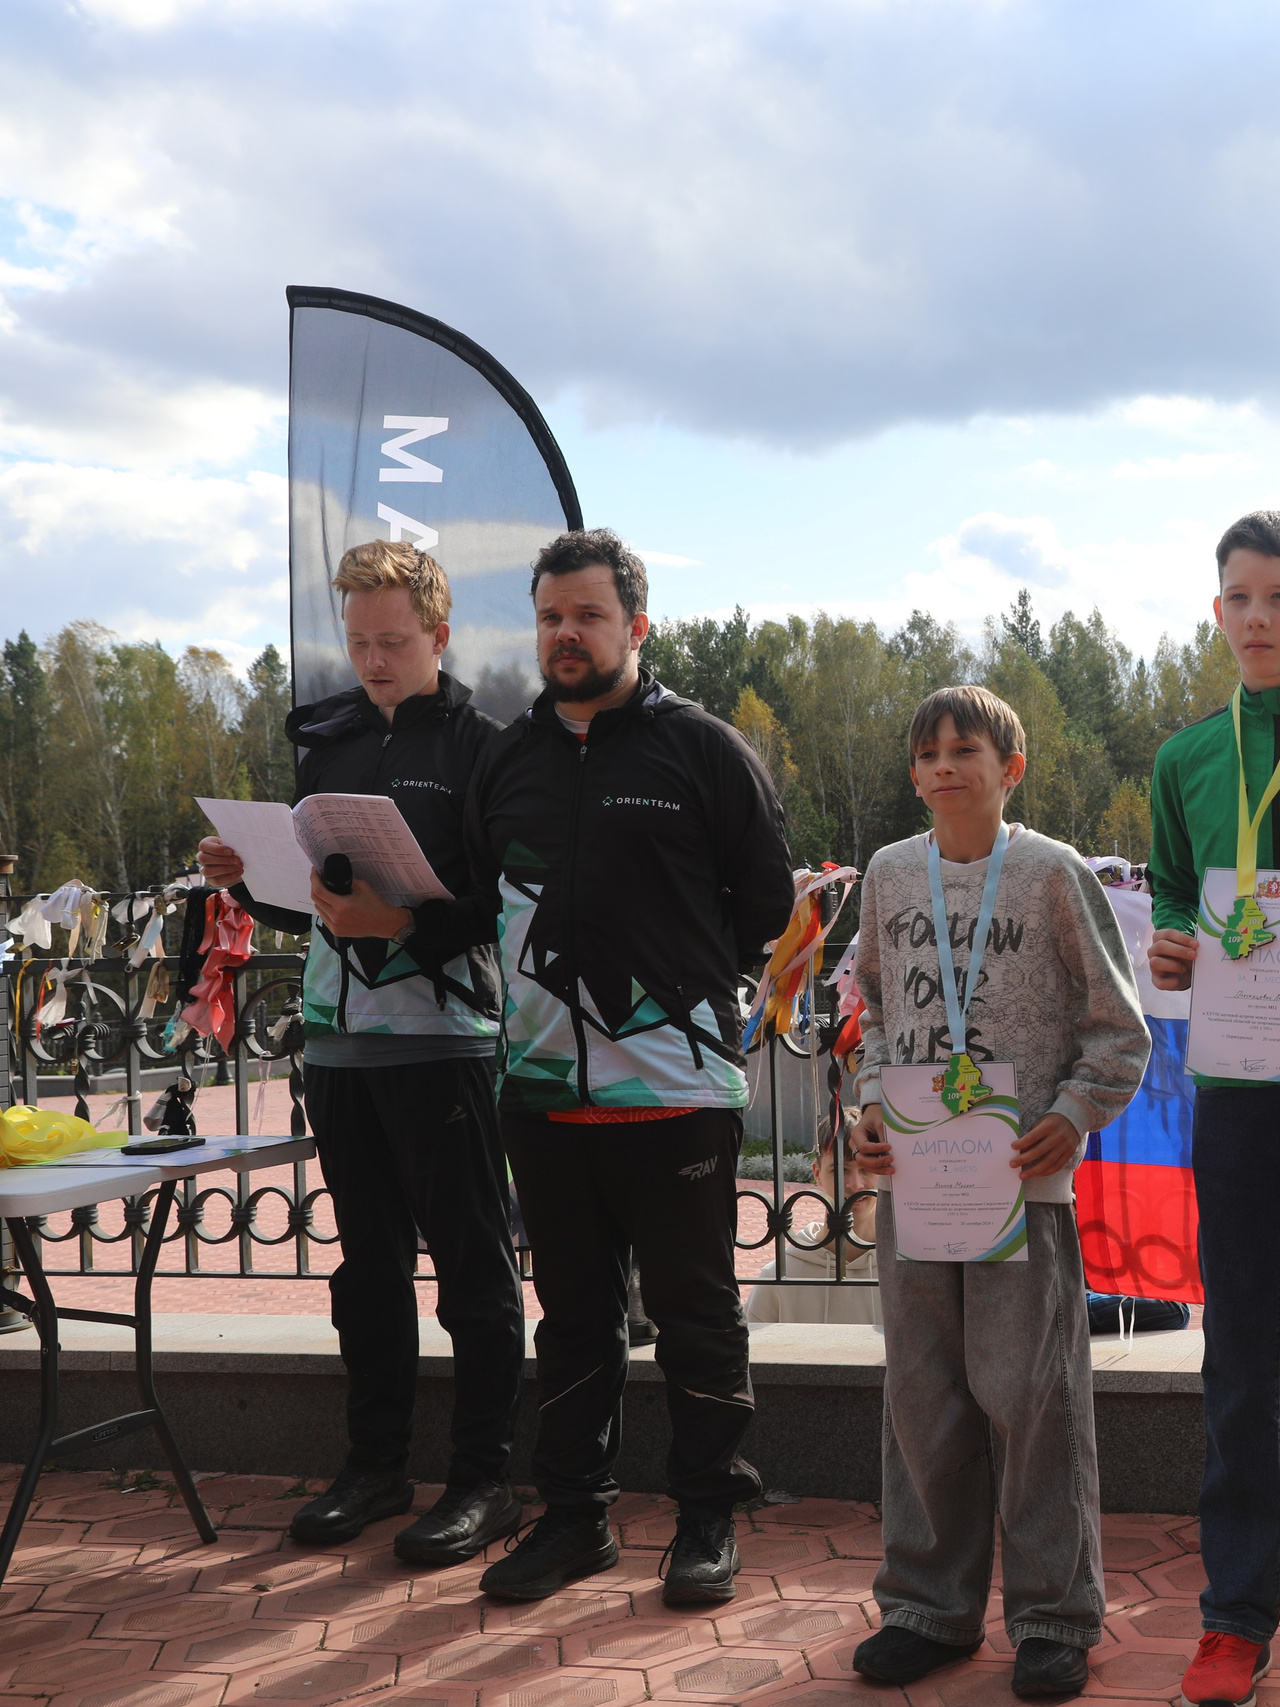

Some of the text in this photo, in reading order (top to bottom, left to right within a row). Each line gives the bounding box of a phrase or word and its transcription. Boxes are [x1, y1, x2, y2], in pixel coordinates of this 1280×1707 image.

[615, 796, 681, 812] ORIENTEAM
[886, 906, 1024, 955] FOLOW
[911, 1139, 993, 1156] ДИПЛОМ
